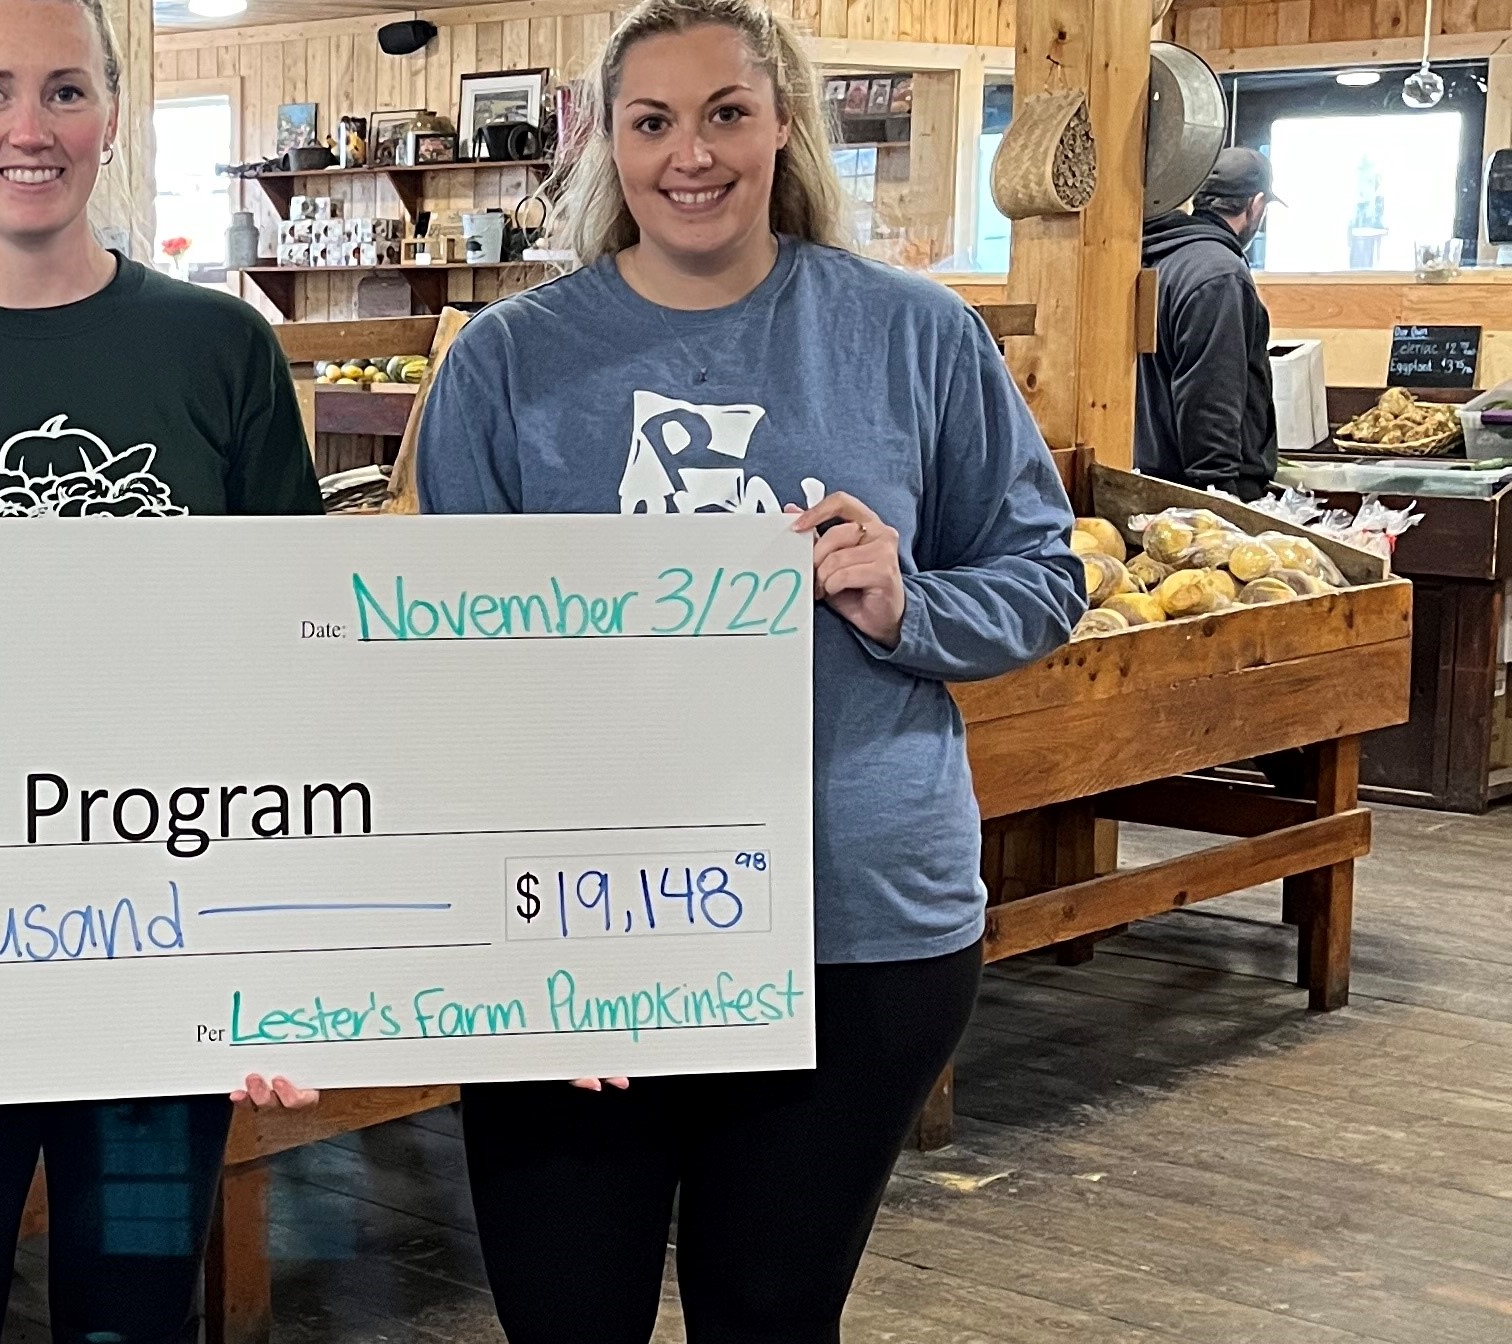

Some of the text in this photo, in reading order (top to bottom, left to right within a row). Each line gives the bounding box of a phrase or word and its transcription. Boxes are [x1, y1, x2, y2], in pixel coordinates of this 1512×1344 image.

[300, 619, 347, 640] Date:
[352, 567, 803, 641] November 3/22
[26, 772, 373, 859] Program
[196, 1023, 225, 1044] Per
[230, 968, 805, 1044] Lester's Farm Pumpkinfest
